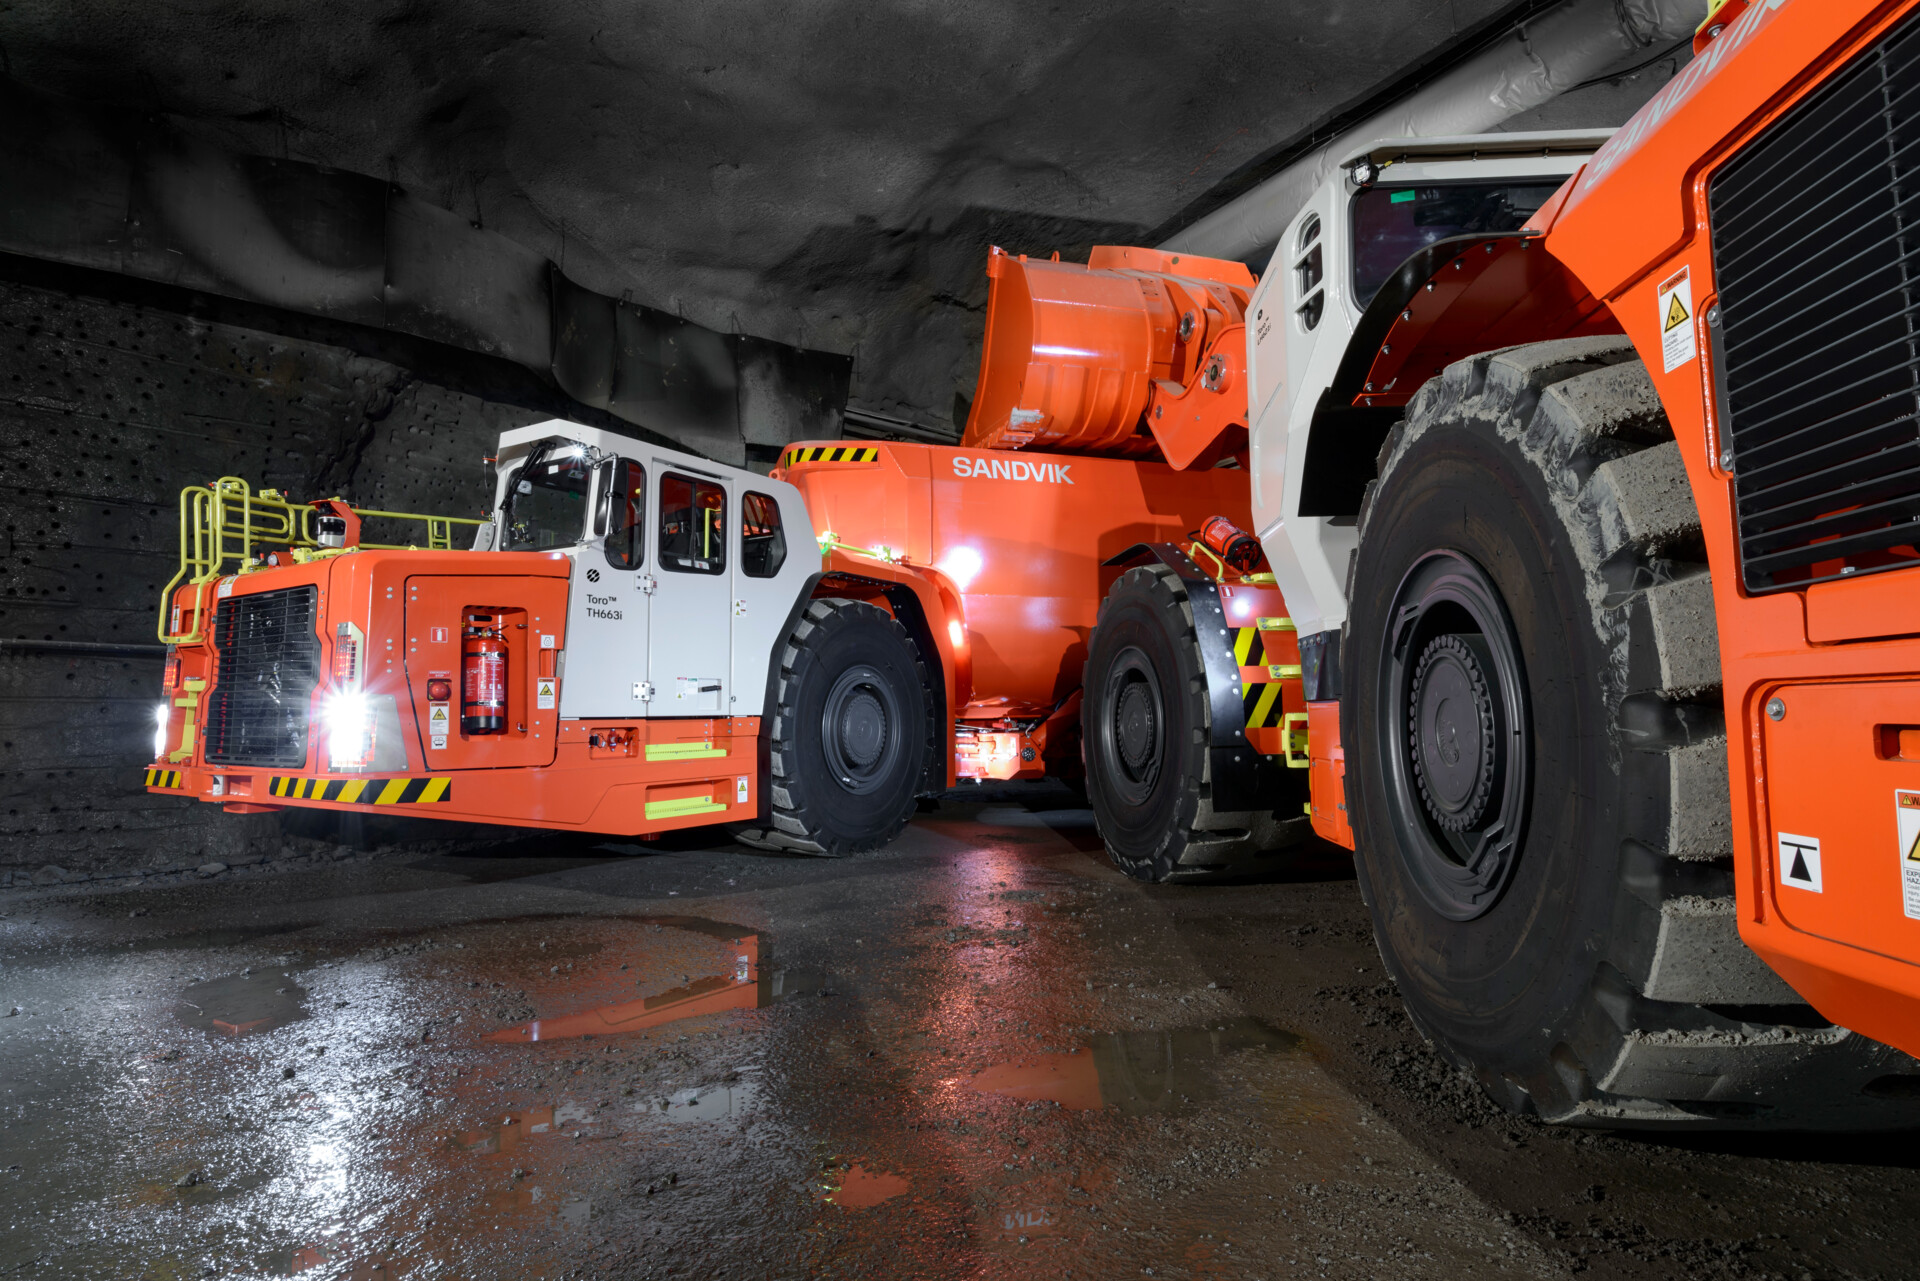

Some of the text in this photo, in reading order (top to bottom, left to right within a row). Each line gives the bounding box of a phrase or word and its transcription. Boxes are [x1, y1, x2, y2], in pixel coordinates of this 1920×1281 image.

[1667, 271, 1687, 289] WARNING
[952, 456, 1075, 485] SANDVIK
[586, 607, 623, 621] TH663i
[1907, 876, 1920, 885] HAZ
